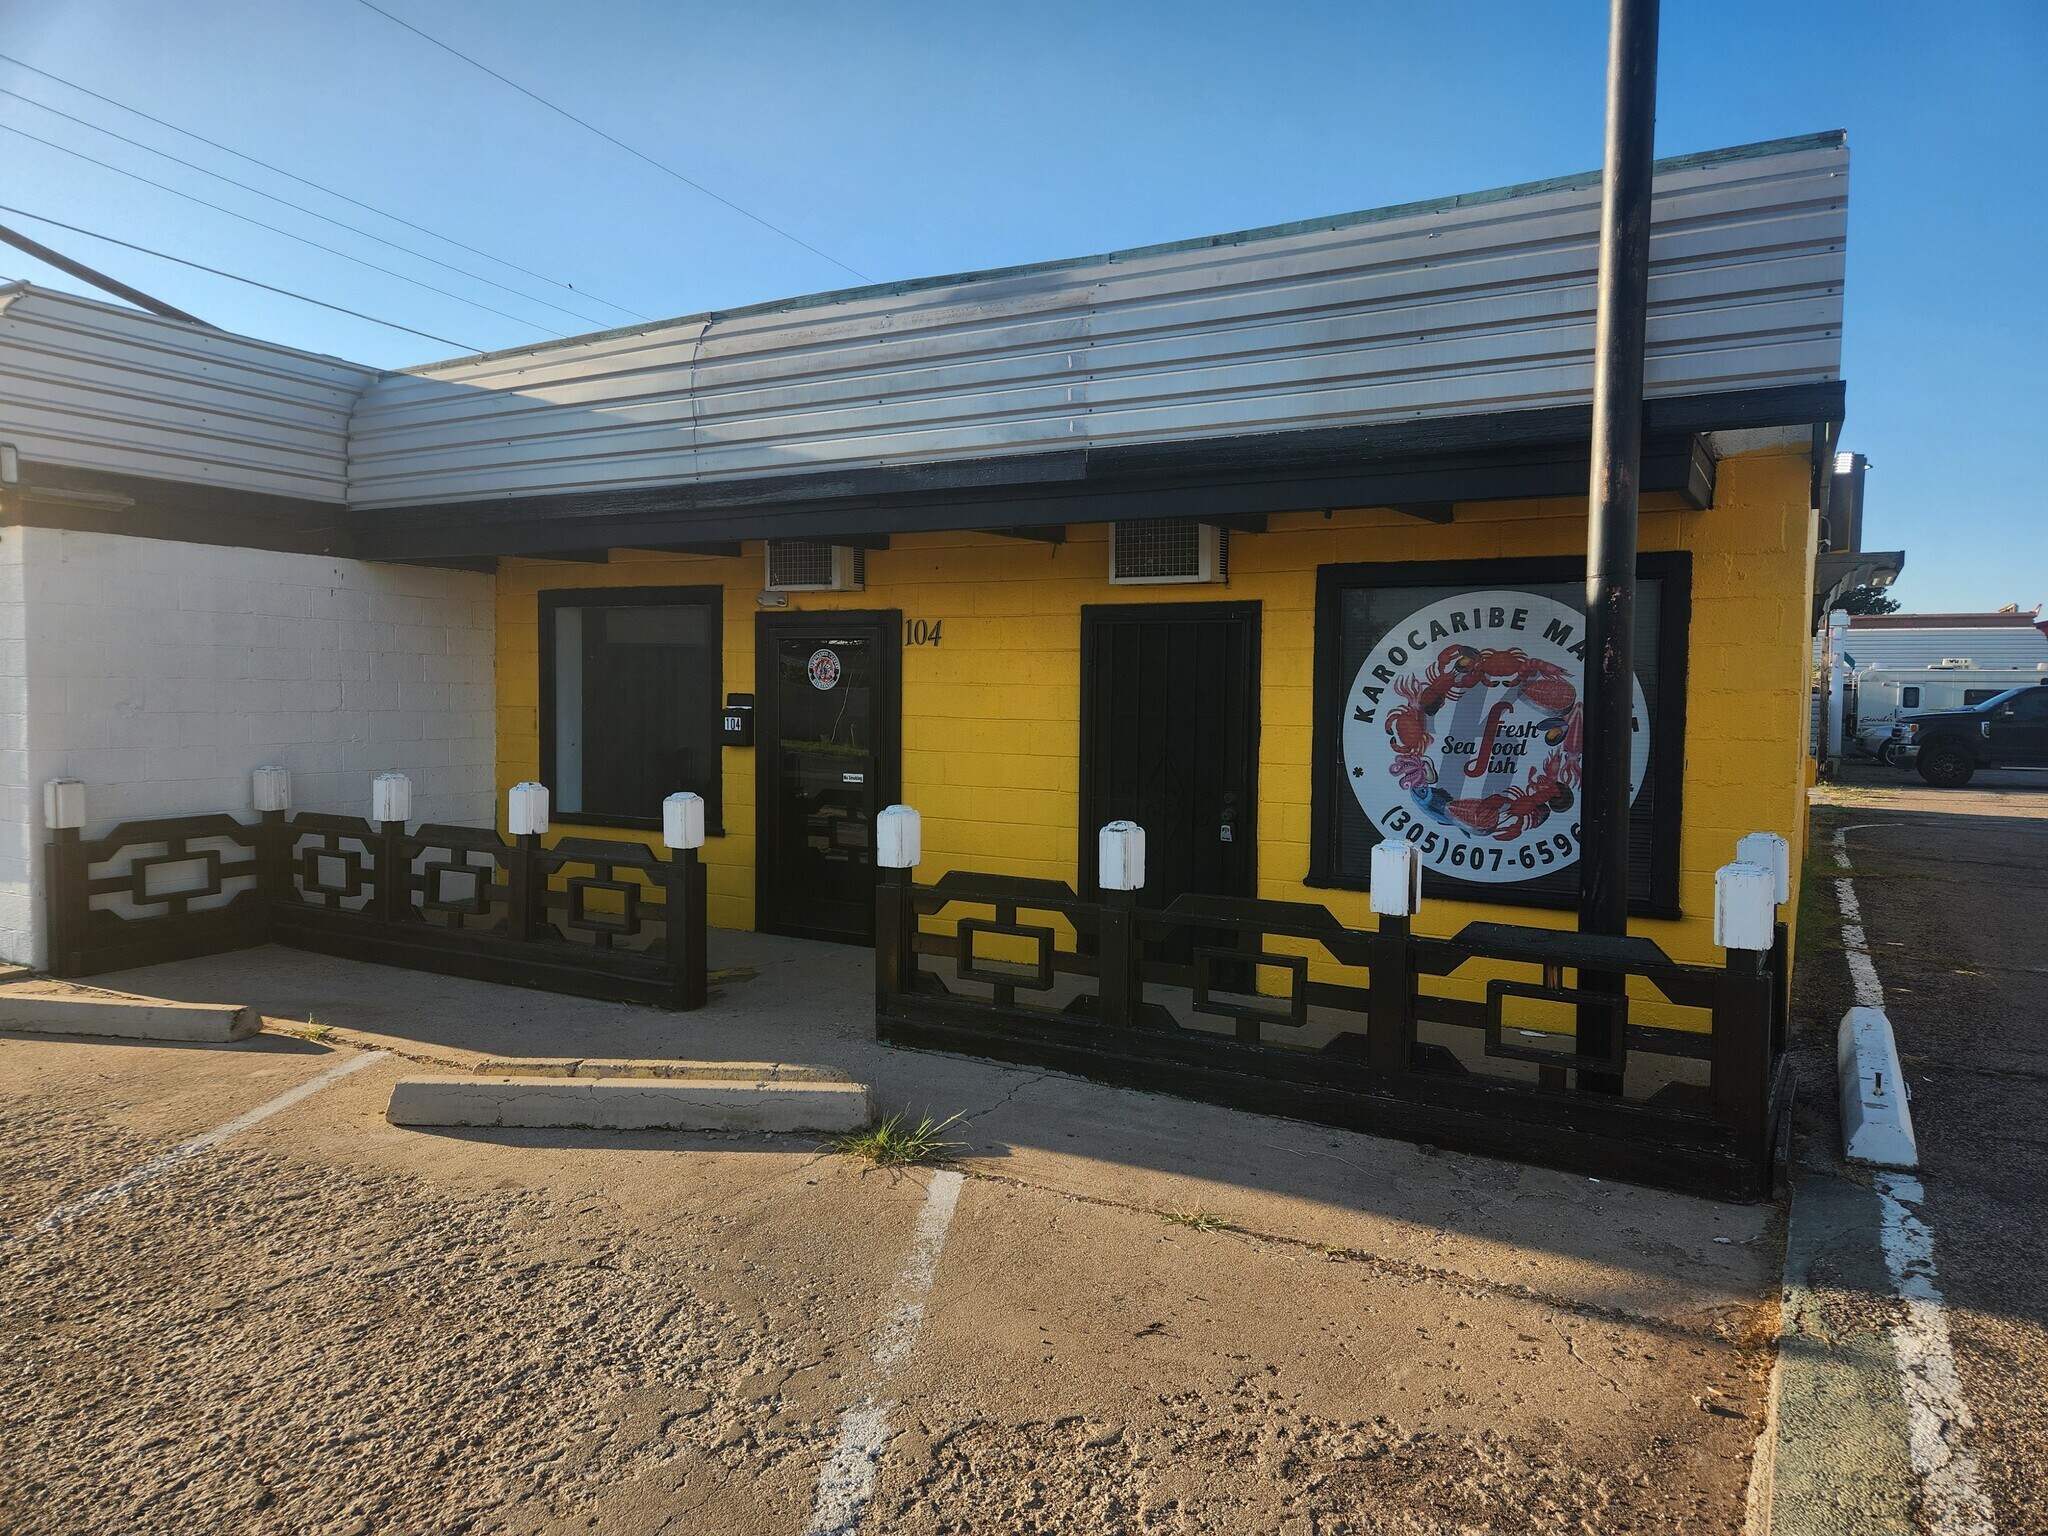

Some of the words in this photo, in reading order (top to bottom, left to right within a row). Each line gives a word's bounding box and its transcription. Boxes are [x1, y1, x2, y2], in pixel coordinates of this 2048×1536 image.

[904, 618, 942, 647] 104
[1353, 606, 1529, 724] KAROCARIBE
[725, 717, 740, 730] 104
